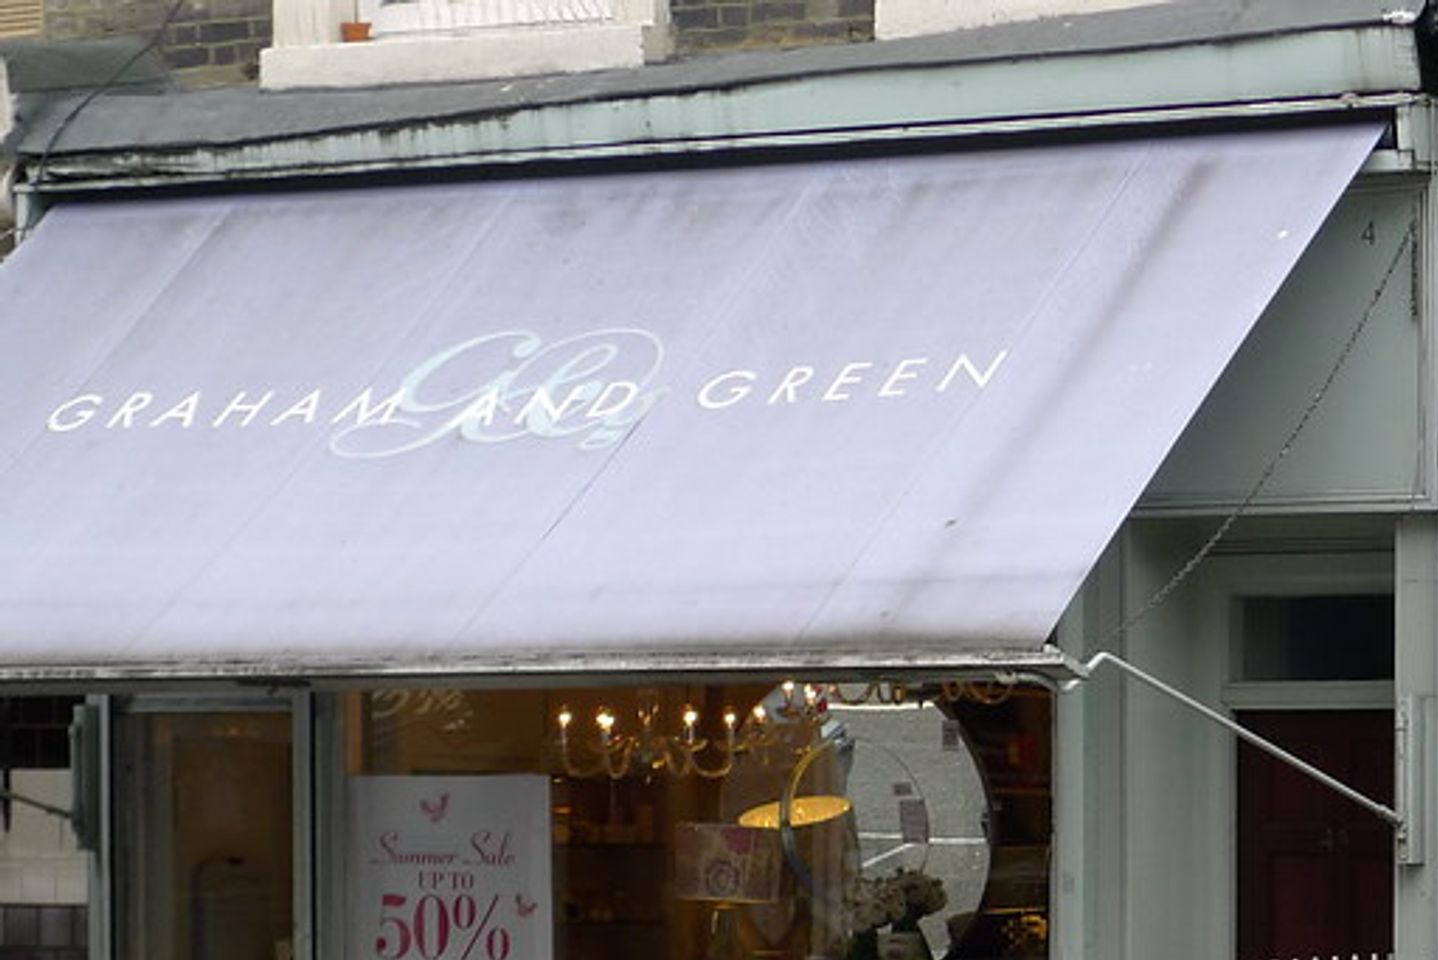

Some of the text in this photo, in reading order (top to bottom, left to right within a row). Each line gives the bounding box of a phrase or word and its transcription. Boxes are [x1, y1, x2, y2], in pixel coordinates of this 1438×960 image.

[47, 350, 1008, 432] GRAHAM AND GREEN
[371, 829, 517, 868] Summer Sale
[418, 870, 475, 891] UP TO
